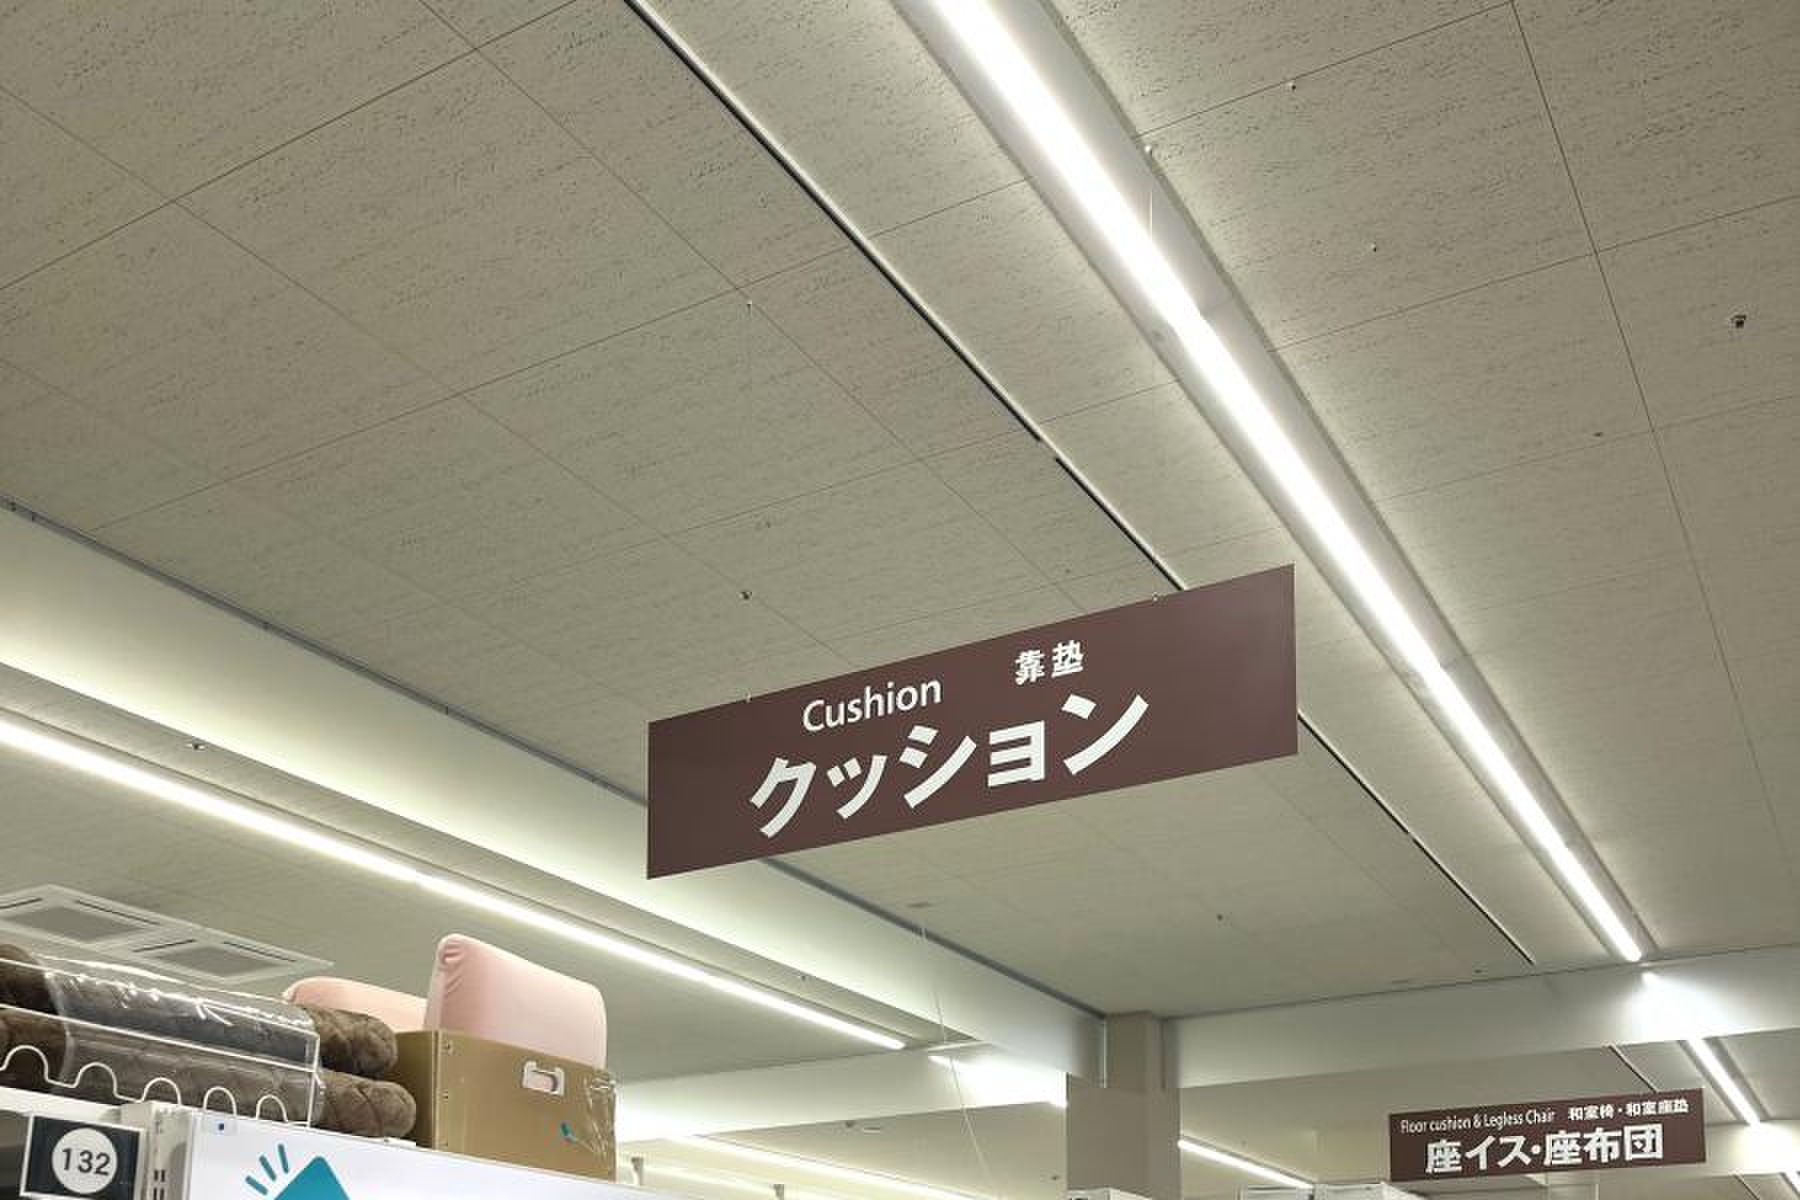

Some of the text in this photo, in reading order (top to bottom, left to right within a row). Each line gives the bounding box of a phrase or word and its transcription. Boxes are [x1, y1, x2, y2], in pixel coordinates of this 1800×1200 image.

[1014, 639, 1084, 685] 靠垫
[802, 679, 942, 733] Cushion
[748, 693, 1149, 838] クッション
[1400, 1107, 1556, 1133] Floor cushion & Legless Chair
[61, 1147, 110, 1176] 132
[1425, 1123, 1663, 1174] 座イス・座布団
